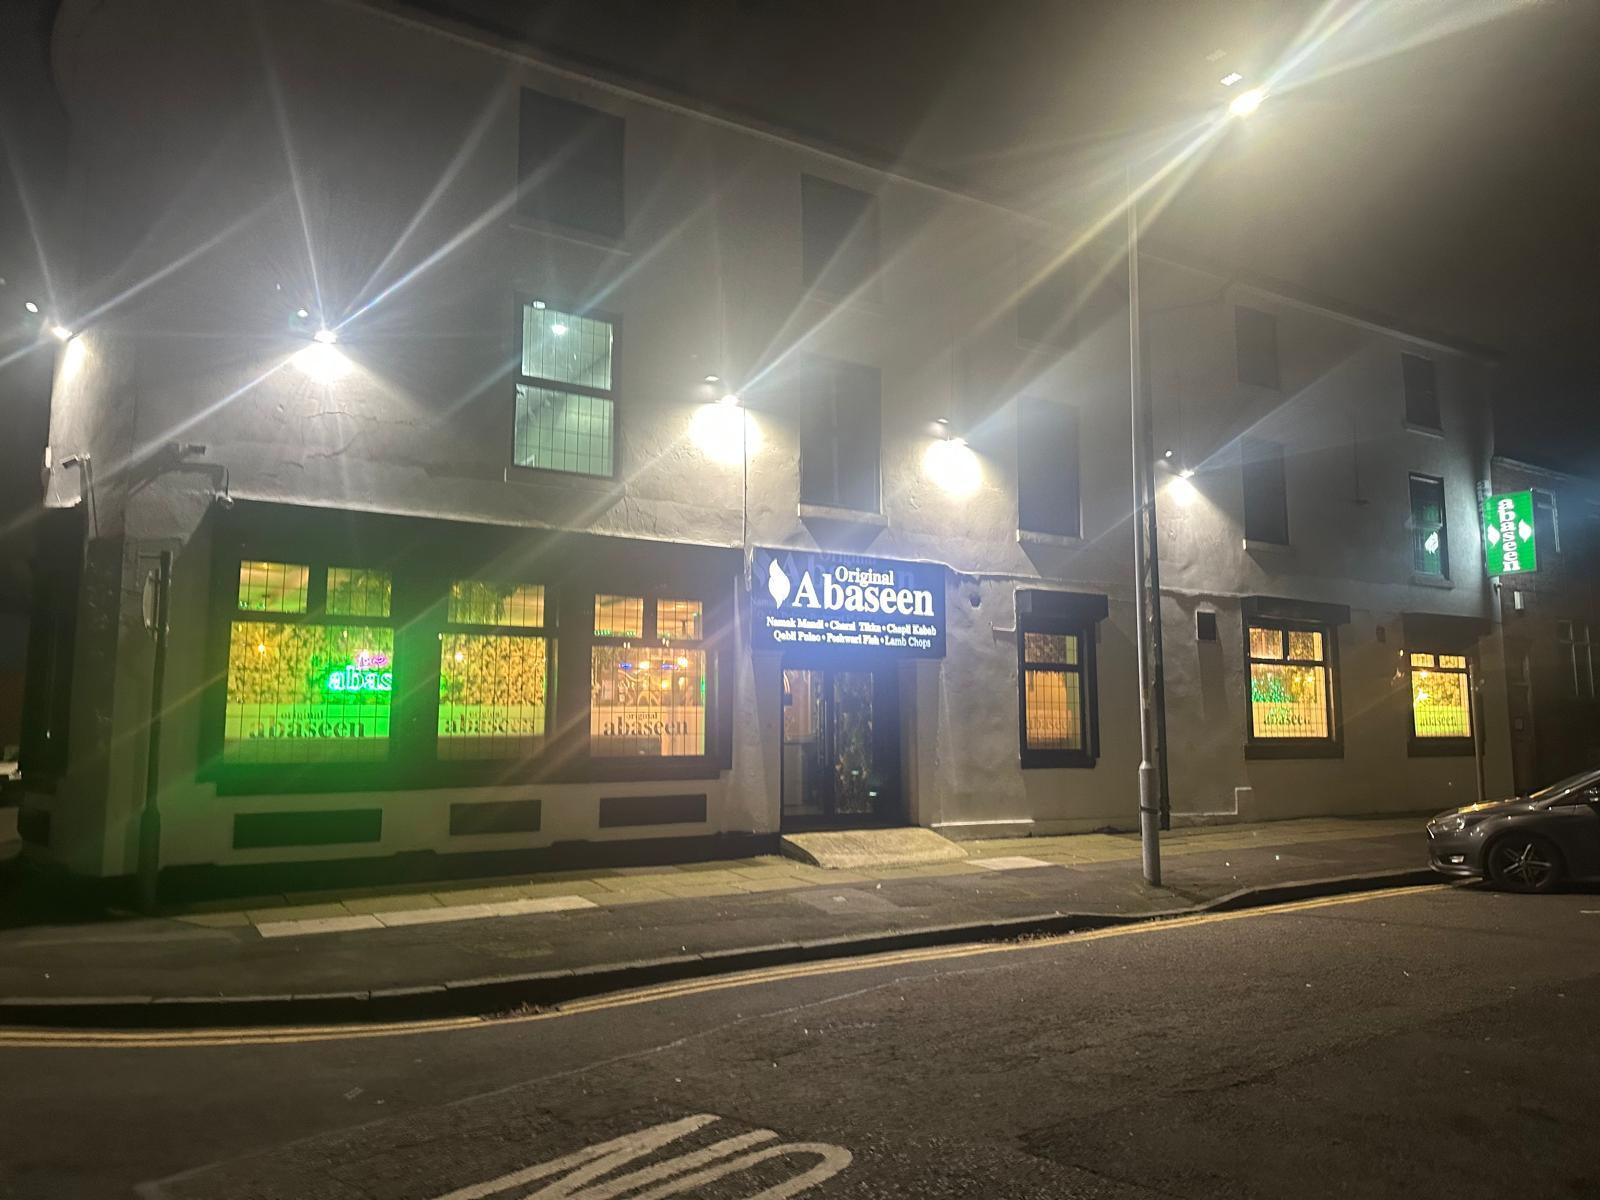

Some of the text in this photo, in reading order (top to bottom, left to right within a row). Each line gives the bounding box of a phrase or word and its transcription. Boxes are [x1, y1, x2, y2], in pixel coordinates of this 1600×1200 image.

[1497, 498, 1520, 572] abaseen
[834, 565, 894, 587] Original
[791, 570, 935, 617] Abaseen
[862, 634, 880, 646] Fish
[884, 635, 906, 647] Lamb
[908, 636, 931, 650] Chops
[603, 715, 688, 736] abaseen
